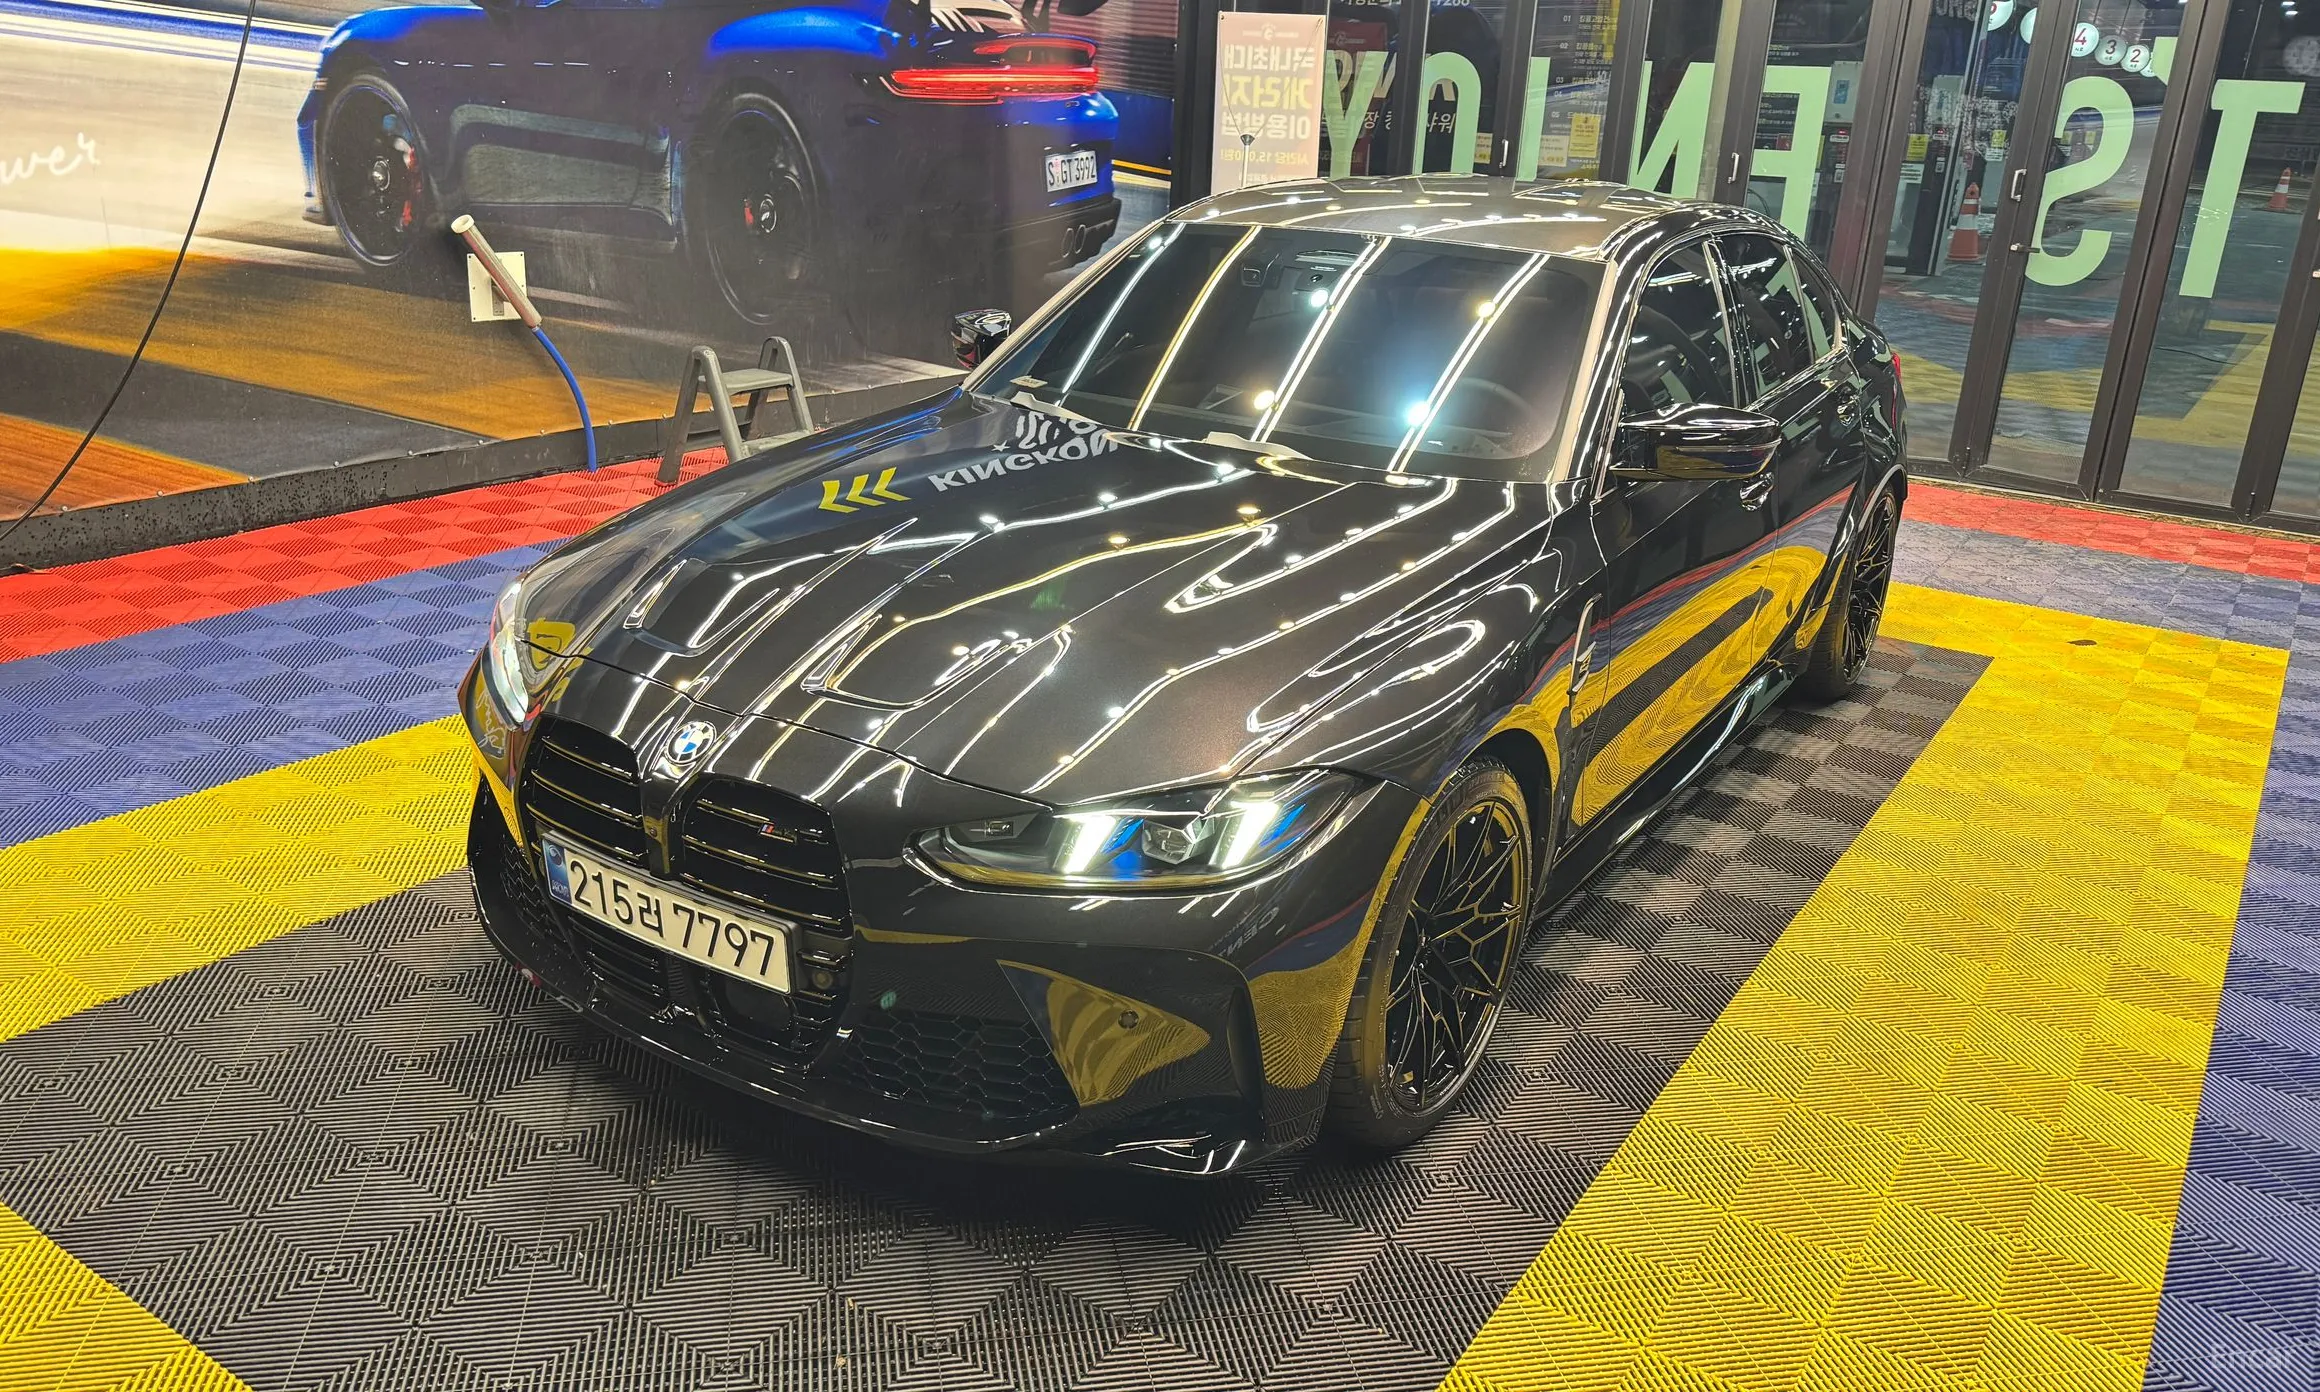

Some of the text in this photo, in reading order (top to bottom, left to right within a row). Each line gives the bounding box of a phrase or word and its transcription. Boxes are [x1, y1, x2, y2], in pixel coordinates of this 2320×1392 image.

[2074, 28, 2087, 46] 4
[2105, 40, 2117, 55] 3
[2130, 48, 2141, 63] 2
[1048, 155, 1096, 186] S GT 3992
[570, 860, 775, 976] 215러 7797
